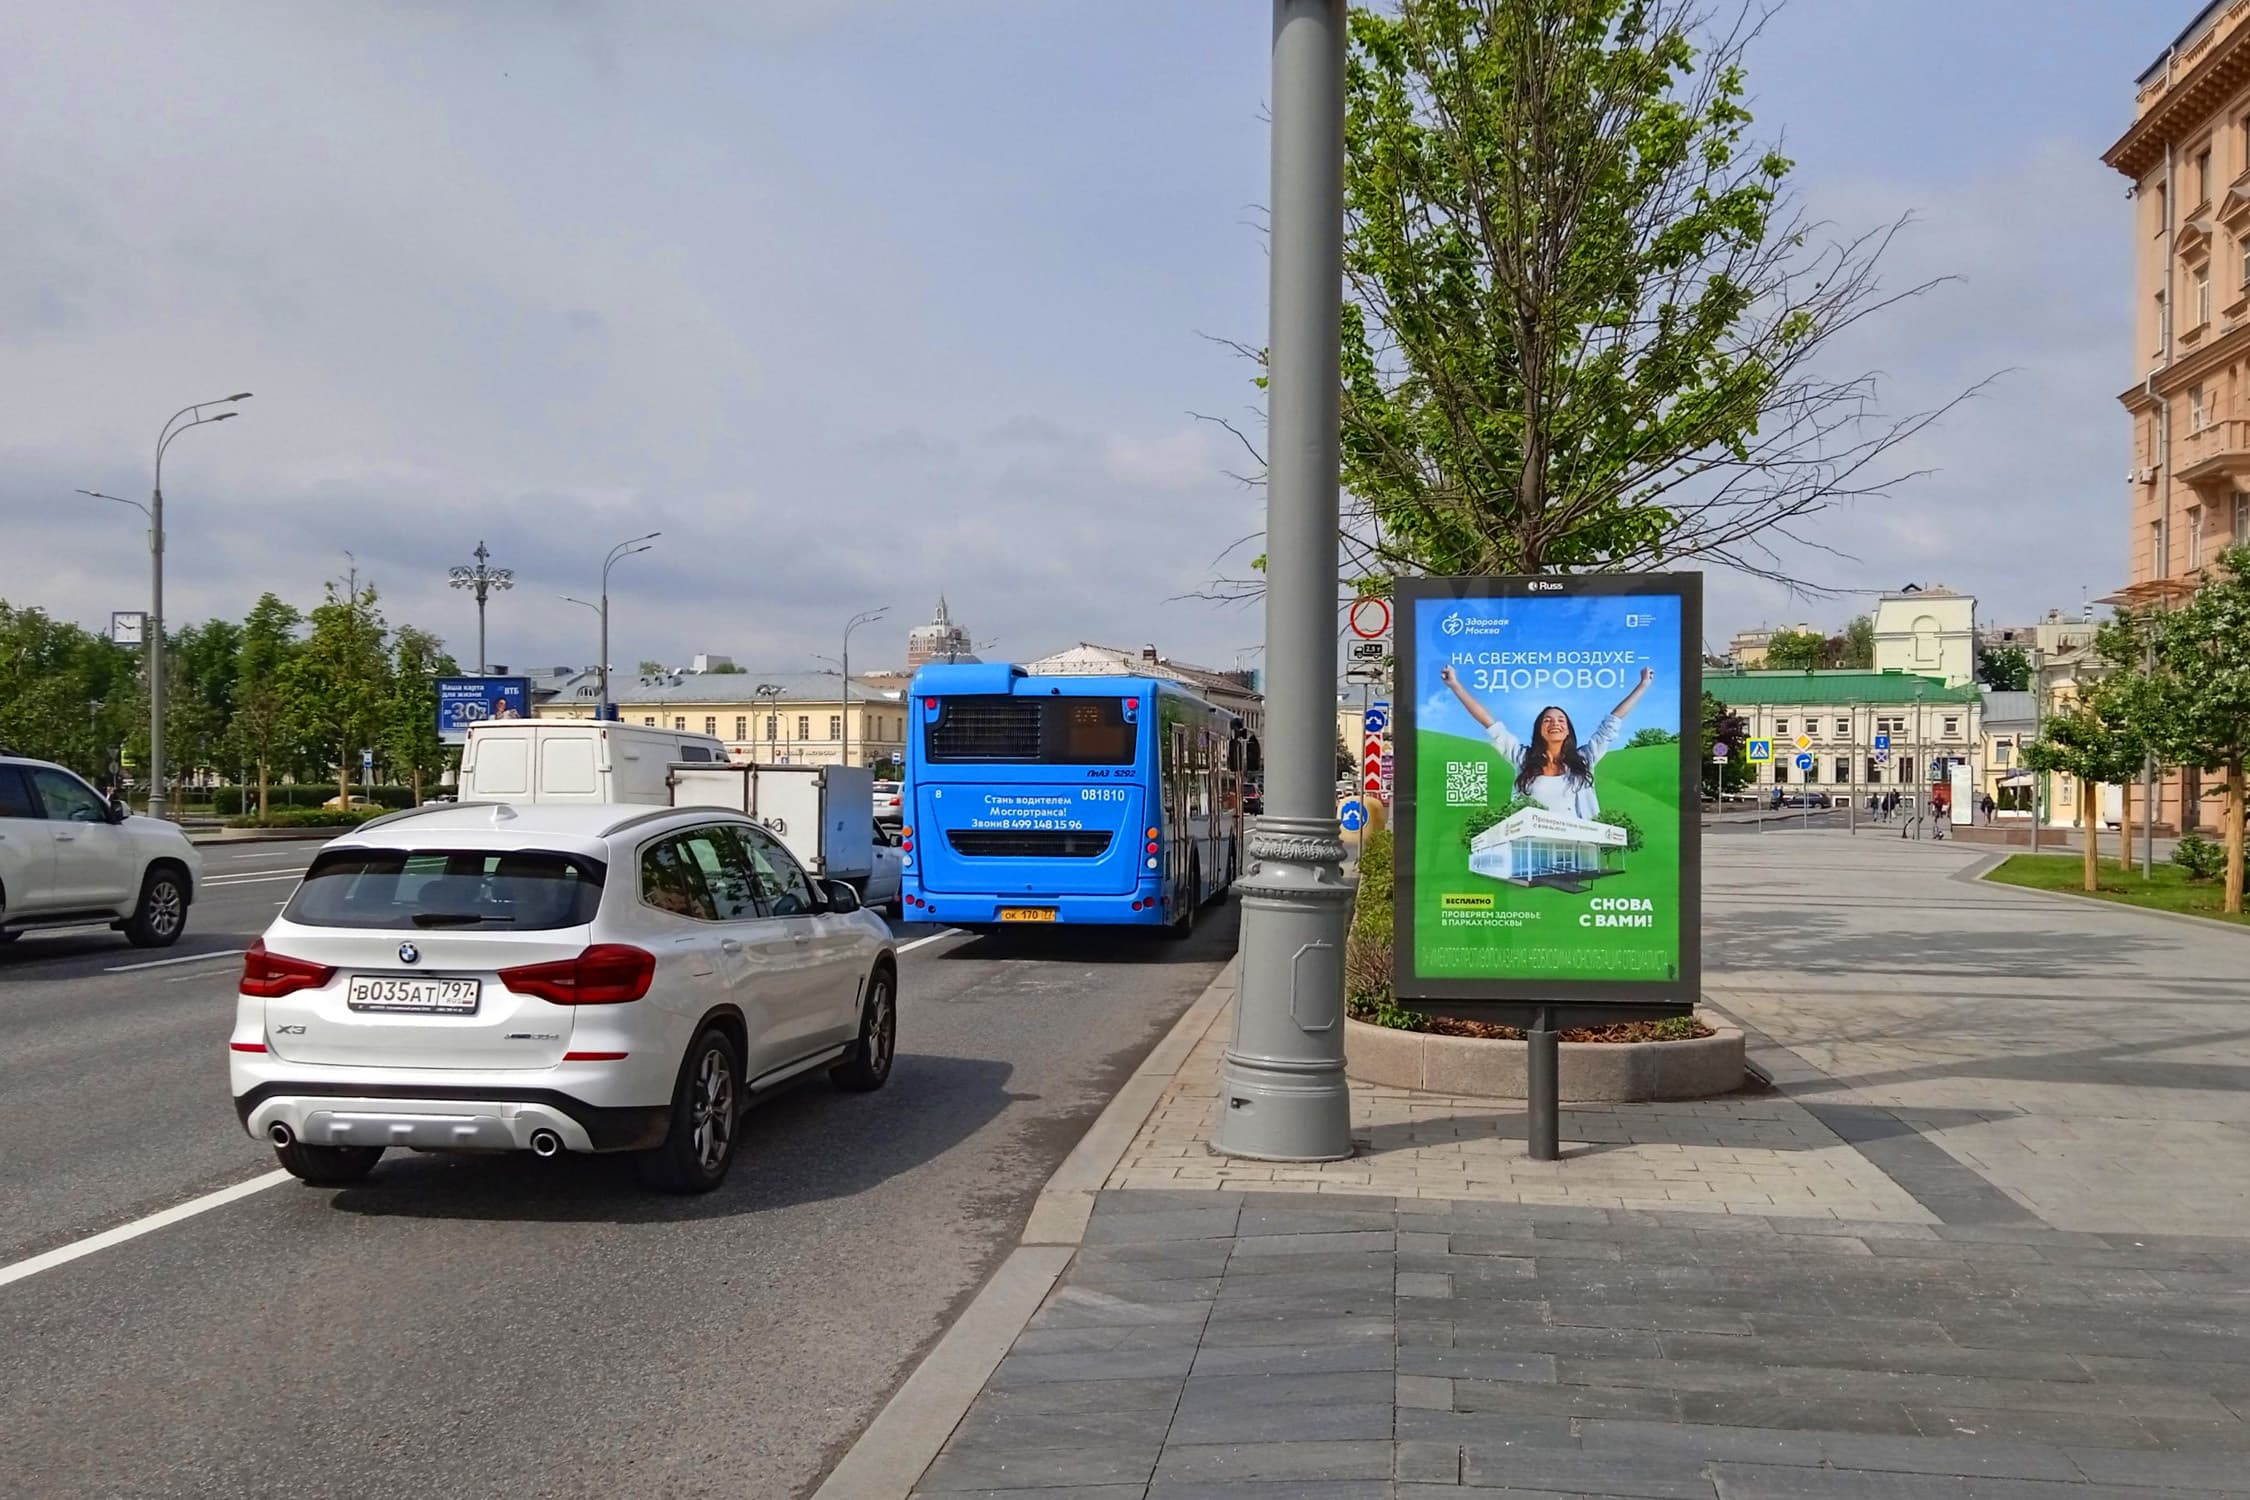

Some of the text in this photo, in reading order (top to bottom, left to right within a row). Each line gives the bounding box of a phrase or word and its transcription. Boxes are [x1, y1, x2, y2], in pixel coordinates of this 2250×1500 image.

[1539, 581, 1564, 591] Russ
[1465, 617, 1509, 627] Здоровая
[1465, 627, 1500, 635] Москва
[1451, 652, 1475, 665] НА
[1478, 652, 1551, 665] СВЕЖЕМ
[1557, 651, 1635, 666] ВОЗДУХЕ
[1473, 668, 1625, 693] ЗДОРОВО!
[504, 687, 519, 695] ВТБ
[935, 789, 942, 799] 8
[984, 794, 1072, 805] Стань водителем
[1081, 788, 1125, 801] 081810
[989, 807, 1067, 818] Мосгортранса!
[971, 818, 1003, 828] Звони
[1011, 819, 1032, 829] 499
[1034, 819, 1052, 829] 148
[1054, 820, 1067, 829] 15
[1068, 820, 1082, 830] 96
[1590, 897, 1654, 911] СНОВА
[1441, 910, 1541, 919] ПРОВЕРЯЕМ ЗДОРОВЬЕ
[1484, 919, 1522, 927] МОСКВЫ
[1579, 914, 1653, 928] С ВАМИ!
[441, 982, 473, 998] 797
[275, 1025, 306, 1035] X3
